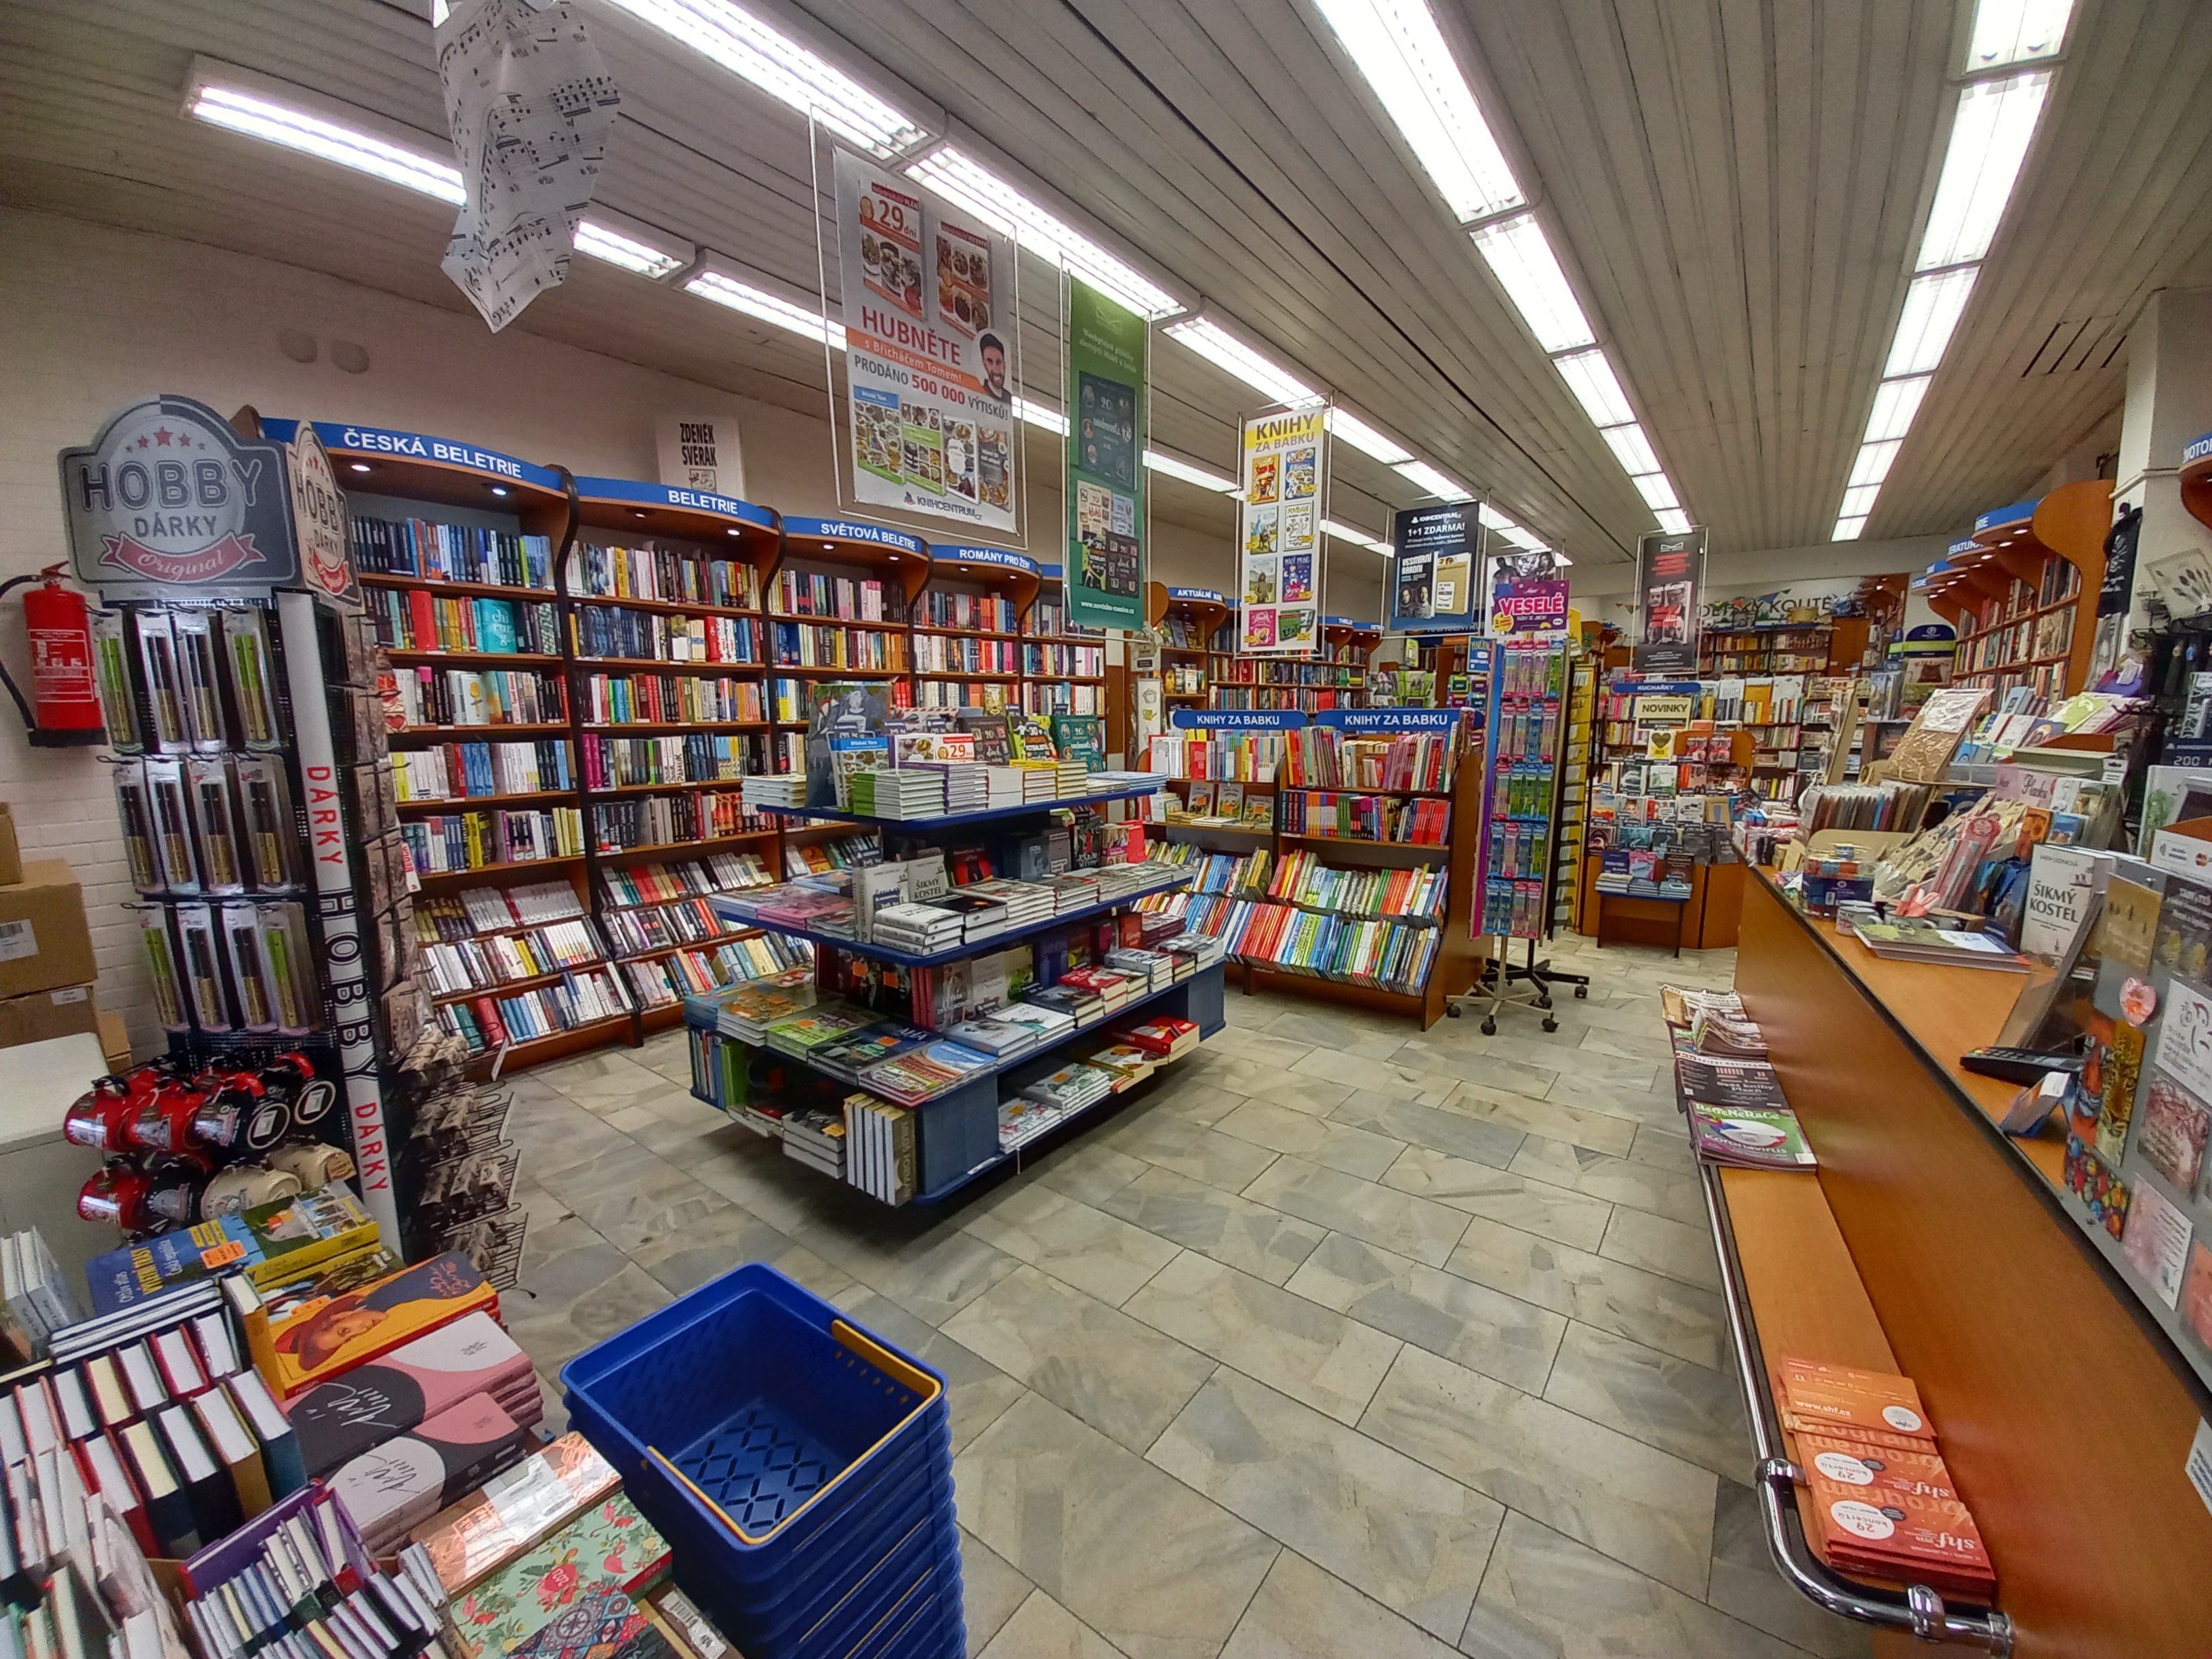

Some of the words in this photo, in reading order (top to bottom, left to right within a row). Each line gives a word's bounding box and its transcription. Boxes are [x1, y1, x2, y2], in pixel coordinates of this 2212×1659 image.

[878, 199, 903, 232] 29
[862, 305, 962, 366] HUBNĚTE
[864, 340, 870, 349] s
[927, 361, 963, 384] Tomem!
[854, 354, 909, 386] PRODÁNO
[912, 374, 938, 396] 500
[941, 386, 966, 405] 000
[968, 394, 1009, 421] VÝTISKŮ!
[1256, 413, 1315, 441] KNIHY
[344, 428, 428, 456] ČESKÁ
[433, 445, 523, 478] BELETRIE
[1255, 442, 1271, 453] ZA
[1273, 432, 1315, 449] BABKU
[80, 458, 262, 511] HOBBY
[668, 489, 738, 514] BELETRIE
[133, 513, 217, 538] DÁRKY
[1408, 527, 1422, 537] 1+1
[1424, 523, 1465, 535] ZDARMA!
[821, 523, 880, 541] SVĚTOVÁ
[881, 531, 916, 552] BELETRIE
[137, 550, 224, 582] Original
[959, 549, 1003, 562] ROMÁNY
[1004, 554, 1019, 566] PRO
[1176, 589, 1212, 599] AKTUÁLNÍ
[1498, 592, 1564, 617] VESELÉ
[1641, 704, 1688, 713] NOVINKY
[1029, 726, 1038, 736] 30
[1196, 715, 1226, 726] KNIHY
[1227, 715, 1242, 726] ZA
[1244, 715, 1280, 726] BABKU
[1345, 714, 1380, 726] KNIHY
[1382, 714, 1401, 726] ZA
[1403, 714, 1448, 726] BABKU
[949, 744, 966, 758] 29
[307, 766, 344, 866] DÁRKY
[914, 886, 943, 900] KOSTEL
[916, 875, 941, 890] ŠIKMÝ
[2034, 879, 2077, 905] ŠIKMÝ
[2030, 897, 2078, 923] KOSTEL
[319, 890, 377, 1080] HOBBY
[354, 1101, 388, 1193] DÁRKY
[1704, 1132, 1788, 1153] Koronavirus
[130, 1246, 155, 1266] TRASY
[157, 1239, 180, 1263] republika
[113, 1271, 130, 1284] atlas
[136, 1263, 164, 1295] VÝLETNÍ
[165, 1262, 184, 1277] Česká
[1912, 1481, 1950, 1498] shf
[1837, 1512, 1889, 1529] koncertů
[1856, 1521, 1876, 1533] 29
[1933, 1532, 1975, 1551] shf
